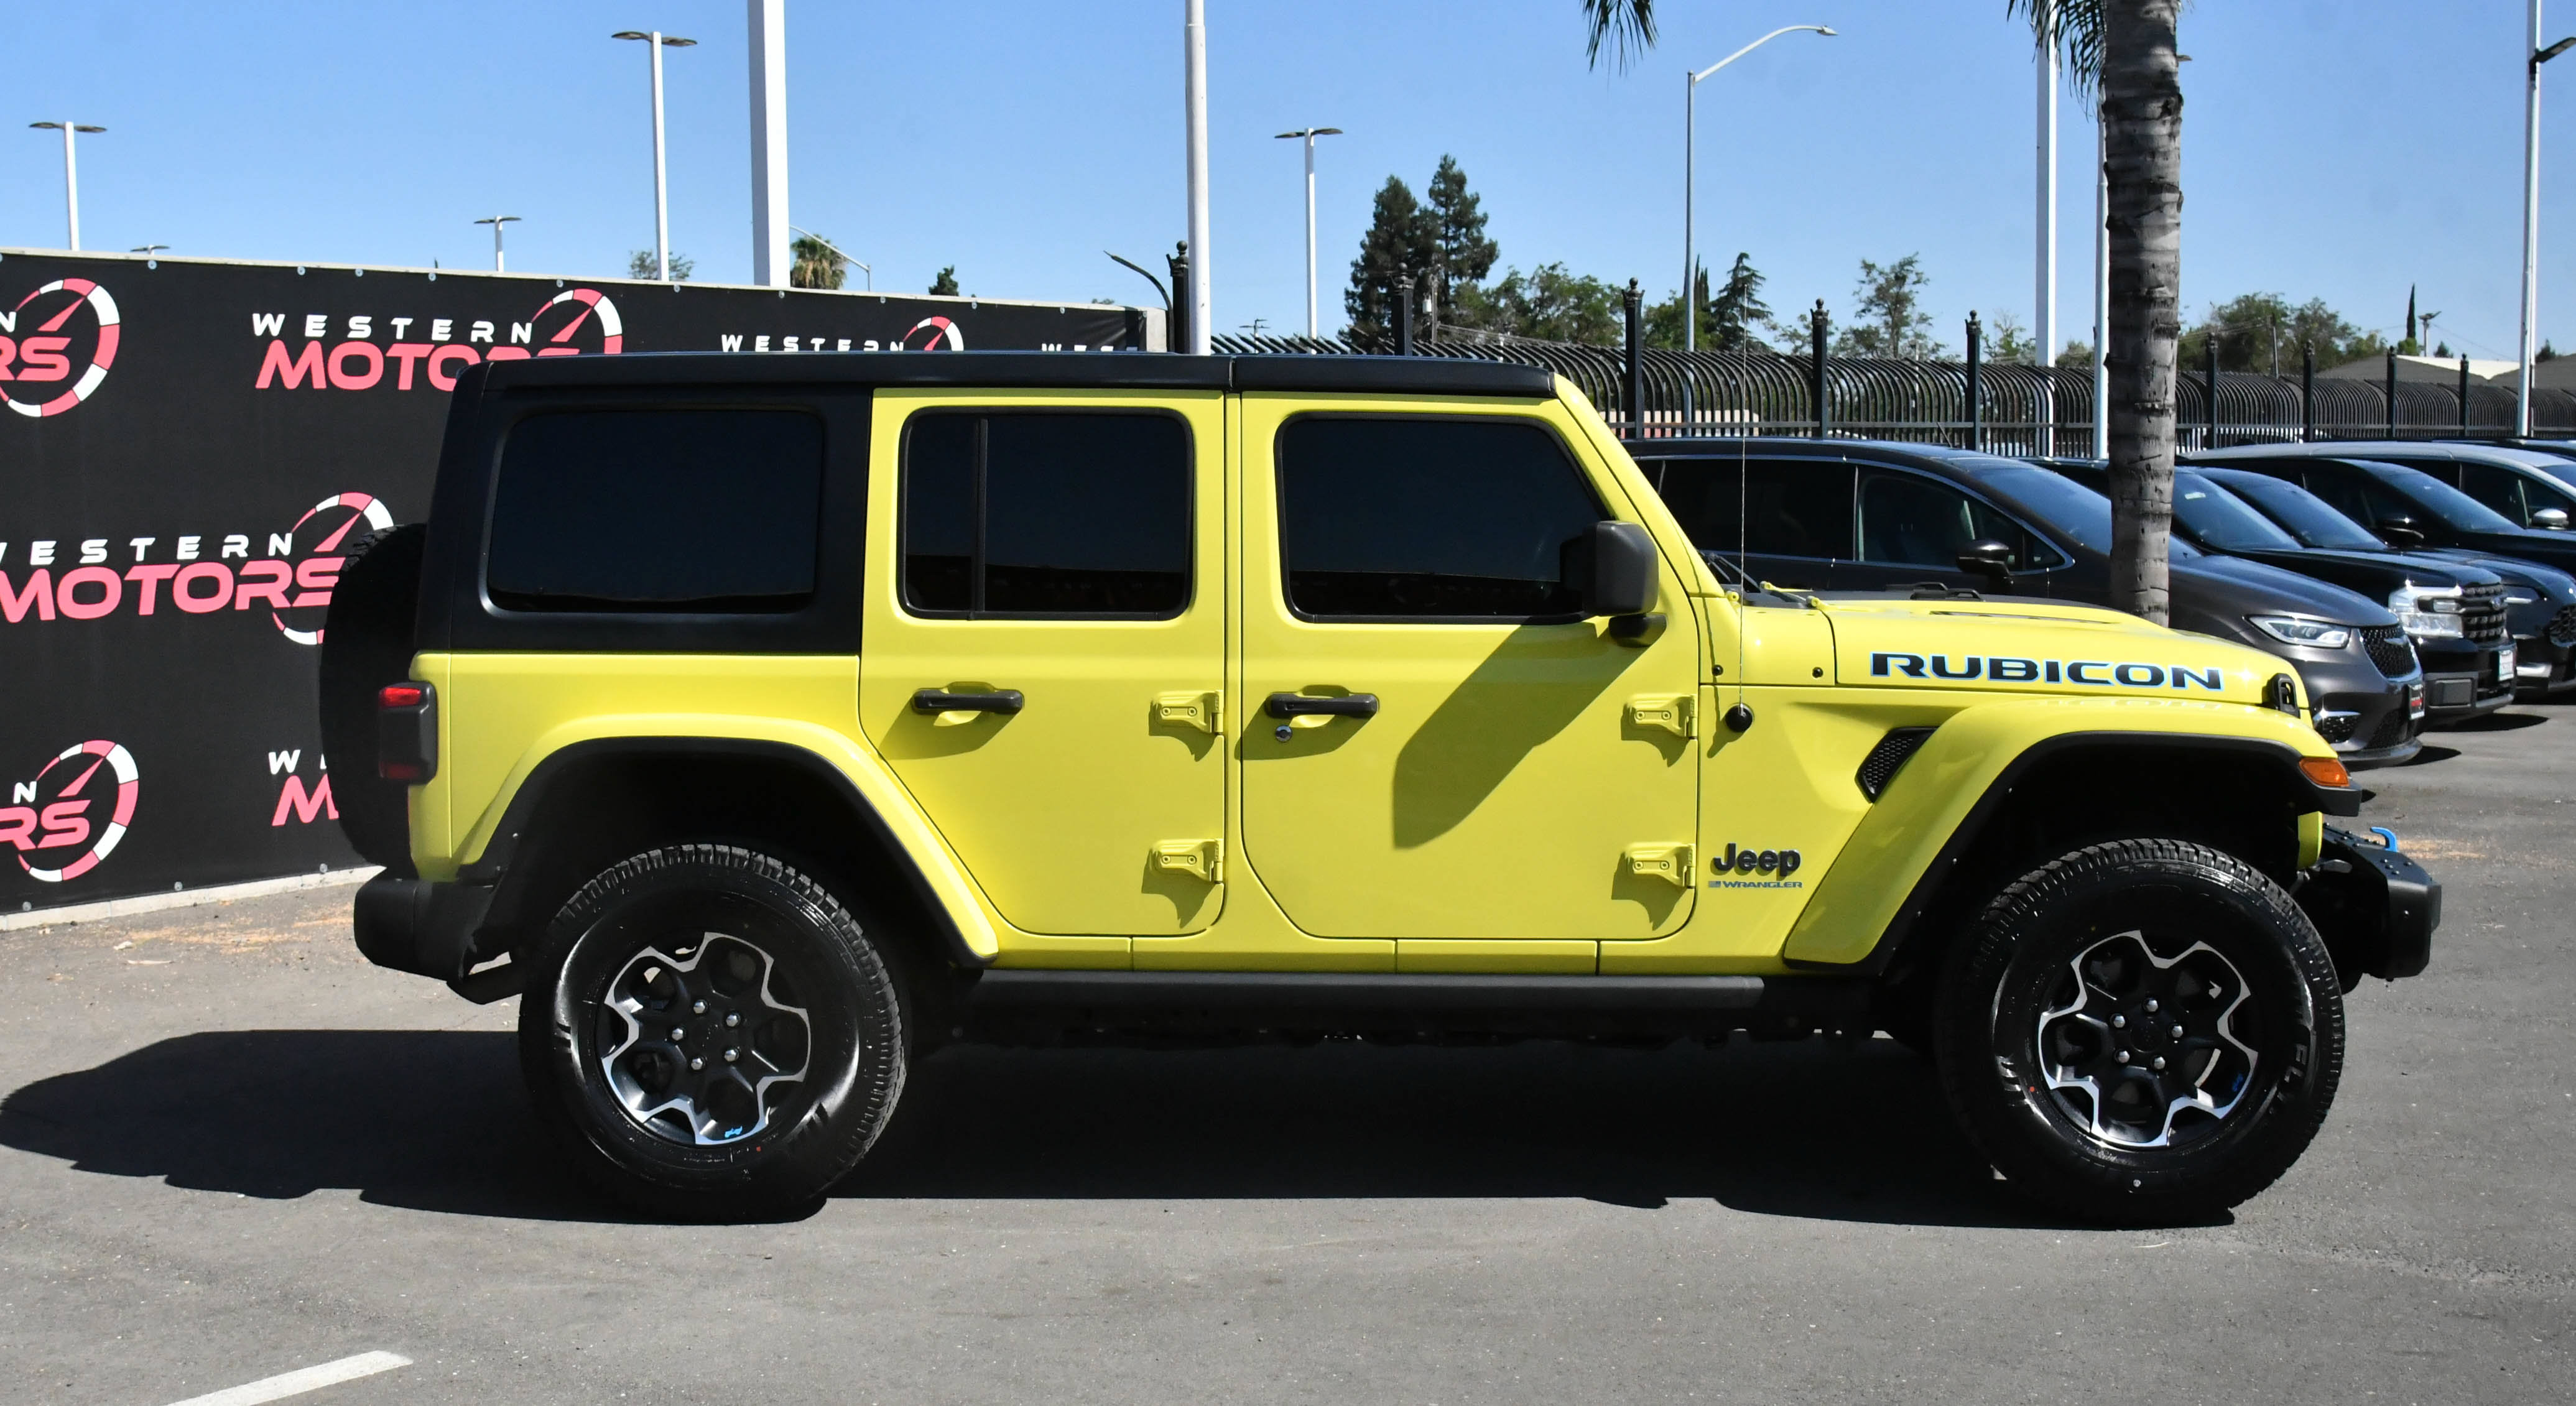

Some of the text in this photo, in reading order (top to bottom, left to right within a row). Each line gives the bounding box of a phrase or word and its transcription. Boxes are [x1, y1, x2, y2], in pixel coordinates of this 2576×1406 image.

[252, 313, 532, 343] WESTERN
[1870, 652, 2224, 691] RUBICON
[1713, 842, 1801, 877] Jeep
